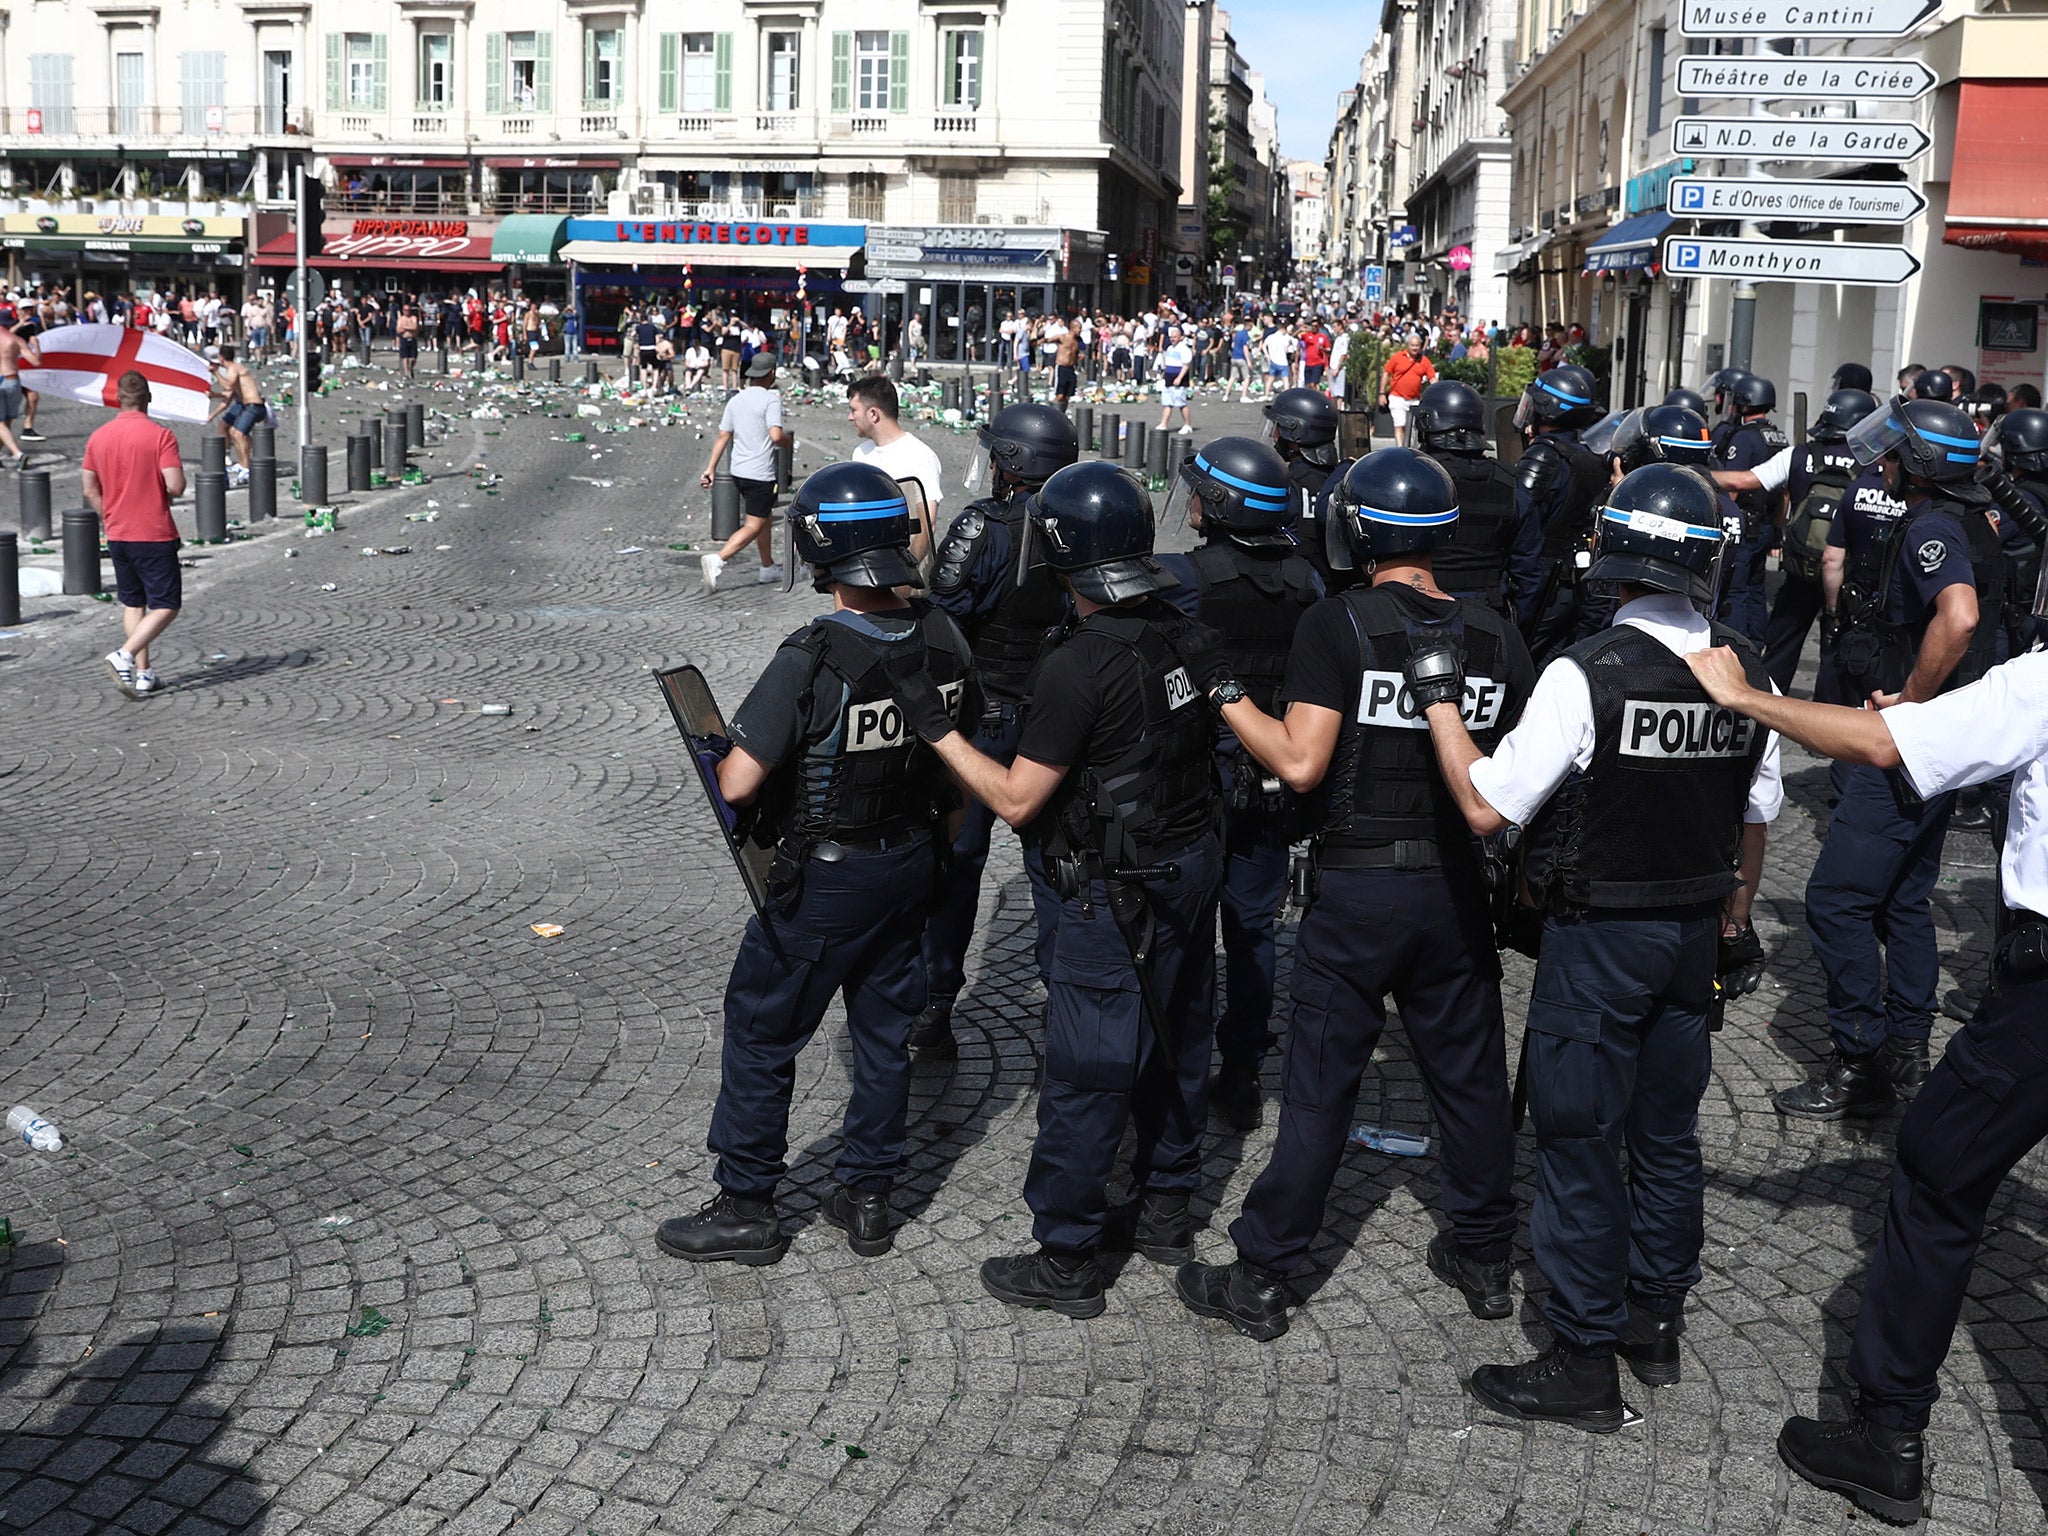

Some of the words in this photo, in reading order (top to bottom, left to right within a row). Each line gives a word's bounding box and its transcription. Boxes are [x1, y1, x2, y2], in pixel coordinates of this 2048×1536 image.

[1692, 7, 1767, 25] Musée
[1785, 7, 1875, 25] Cantini
[1691, 67, 1770, 87] Théâtre
[1783, 69, 1808, 87] de
[1821, 70, 1840, 88] la
[1854, 70, 1914, 89] Criée
[1716, 129, 1757, 147] N.D.
[1772, 130, 1797, 148] de
[1809, 131, 1828, 149] la
[1844, 131, 1909, 150] Garde
[1711, 189, 1724, 207] E.
[1729, 189, 1783, 208] d'Orves
[1786, 194, 1825, 210] (Office
[1828, 195, 1843, 210] de
[1848, 196, 1905, 212] Tourisme)
[352, 218, 468, 237] HIPPOPOTAMUS
[616, 222, 810, 244] L'ENTRECOTE
[923, 229, 1005, 248] TABAC
[323, 234, 471, 256] HIPPO
[491, 253, 518, 263] HOTEL
[525, 254, 550, 263] ALIZE
[1708, 249, 1822, 273] Monthyon
[1367, 679, 1498, 723] POCE
[1630, 707, 1751, 754] POLICE
